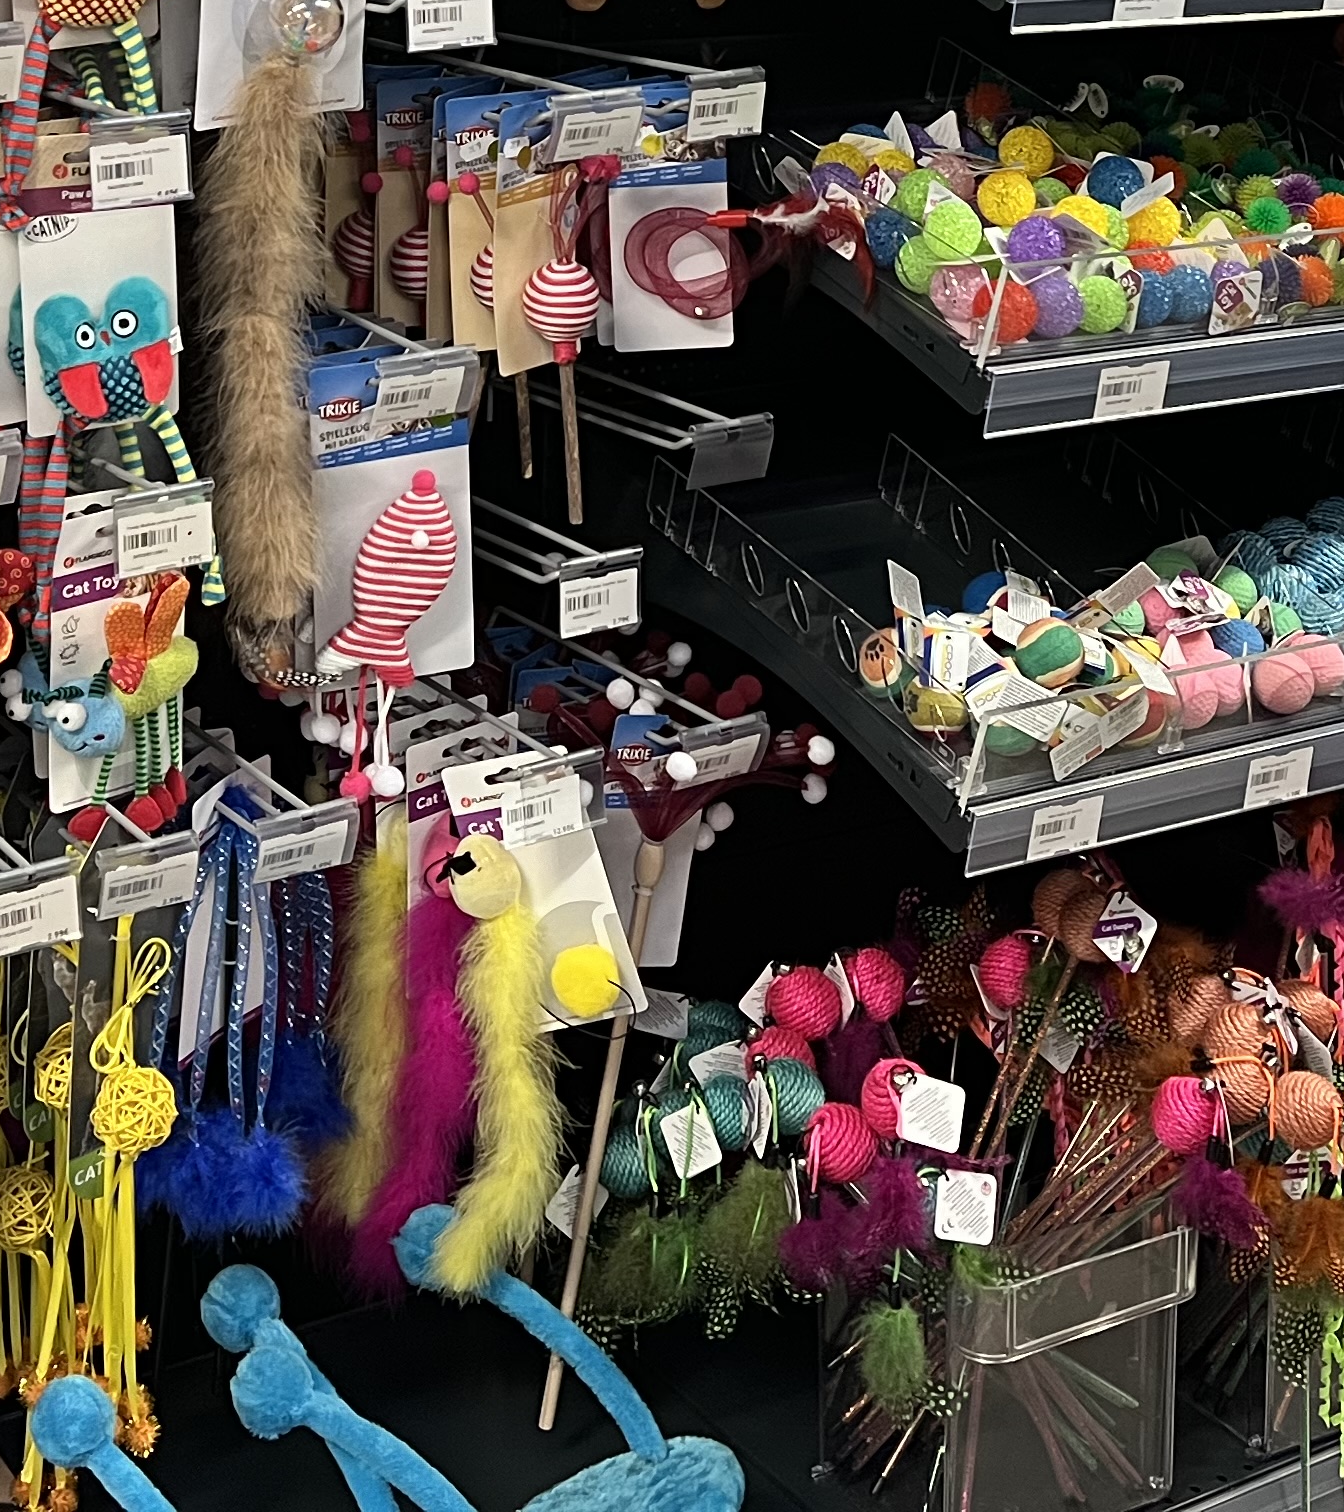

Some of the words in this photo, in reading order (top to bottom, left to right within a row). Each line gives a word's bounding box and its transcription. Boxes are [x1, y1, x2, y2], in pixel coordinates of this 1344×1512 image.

[384, 109, 424, 128] TRIXIE
[33, 217, 72, 237] CATNIP
[318, 398, 361, 419] TRIXIE
[62, 580, 89, 599] Cat
[91, 575, 120, 595] Toy
[616, 746, 654, 761] TRIXIE
[467, 819, 495, 837] Cat
[75, 1161, 104, 1187] CAT
